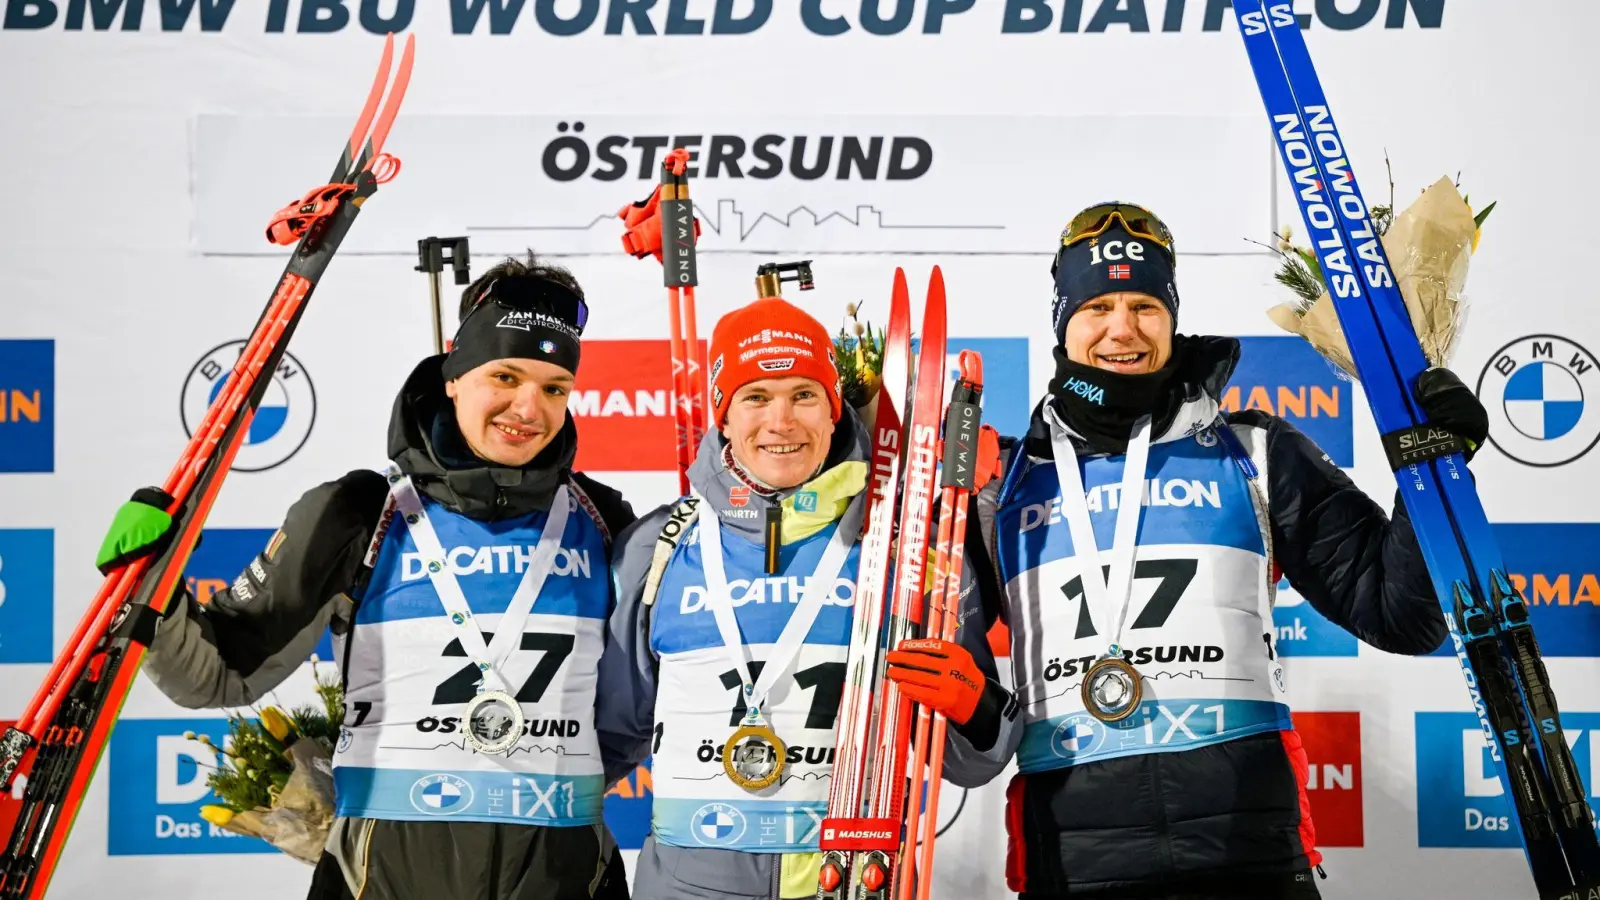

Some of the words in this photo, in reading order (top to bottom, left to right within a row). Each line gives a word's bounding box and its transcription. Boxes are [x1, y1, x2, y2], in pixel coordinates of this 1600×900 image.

[2, 0, 237, 32] BMW
[264, 0, 416, 35] IBU
[448, 0, 774, 36] WORLD
[801, 0, 977, 36] CUP
[1001, 0, 1446, 34] BIATON
[541, 121, 933, 183] ÖSTERSUND
[1274, 113, 1361, 298] SALOMON
[1304, 105, 1393, 289] SALOMON
[1089, 237, 1145, 265] ice
[507, 311, 532, 320] SAN
[200, 347, 298, 382] BW
[1494, 341, 1593, 377] BMW
[1063, 376, 1105, 406] HOKA
[1403, 443, 1455, 461] SELECT
[1060, 558, 1199, 640] 17
[1274, 616, 1308, 641] nk
[432, 631, 576, 705] 27
[1043, 645, 1225, 683] ÖSTRSUND
[719, 660, 848, 730] 11
[1444, 611, 1502, 762] SALOMON
[1142, 704, 1225, 745] iX1
[419, 775, 467, 788] BMW
[512, 777, 574, 819] iX1
[488, 788, 504, 816] THE
[699, 805, 738, 818] BMW
[156, 814, 202, 839] Das
[760, 816, 777, 845] THE
[838, 829, 893, 839] MADSHUS
[1464, 808, 1510, 832] Das
